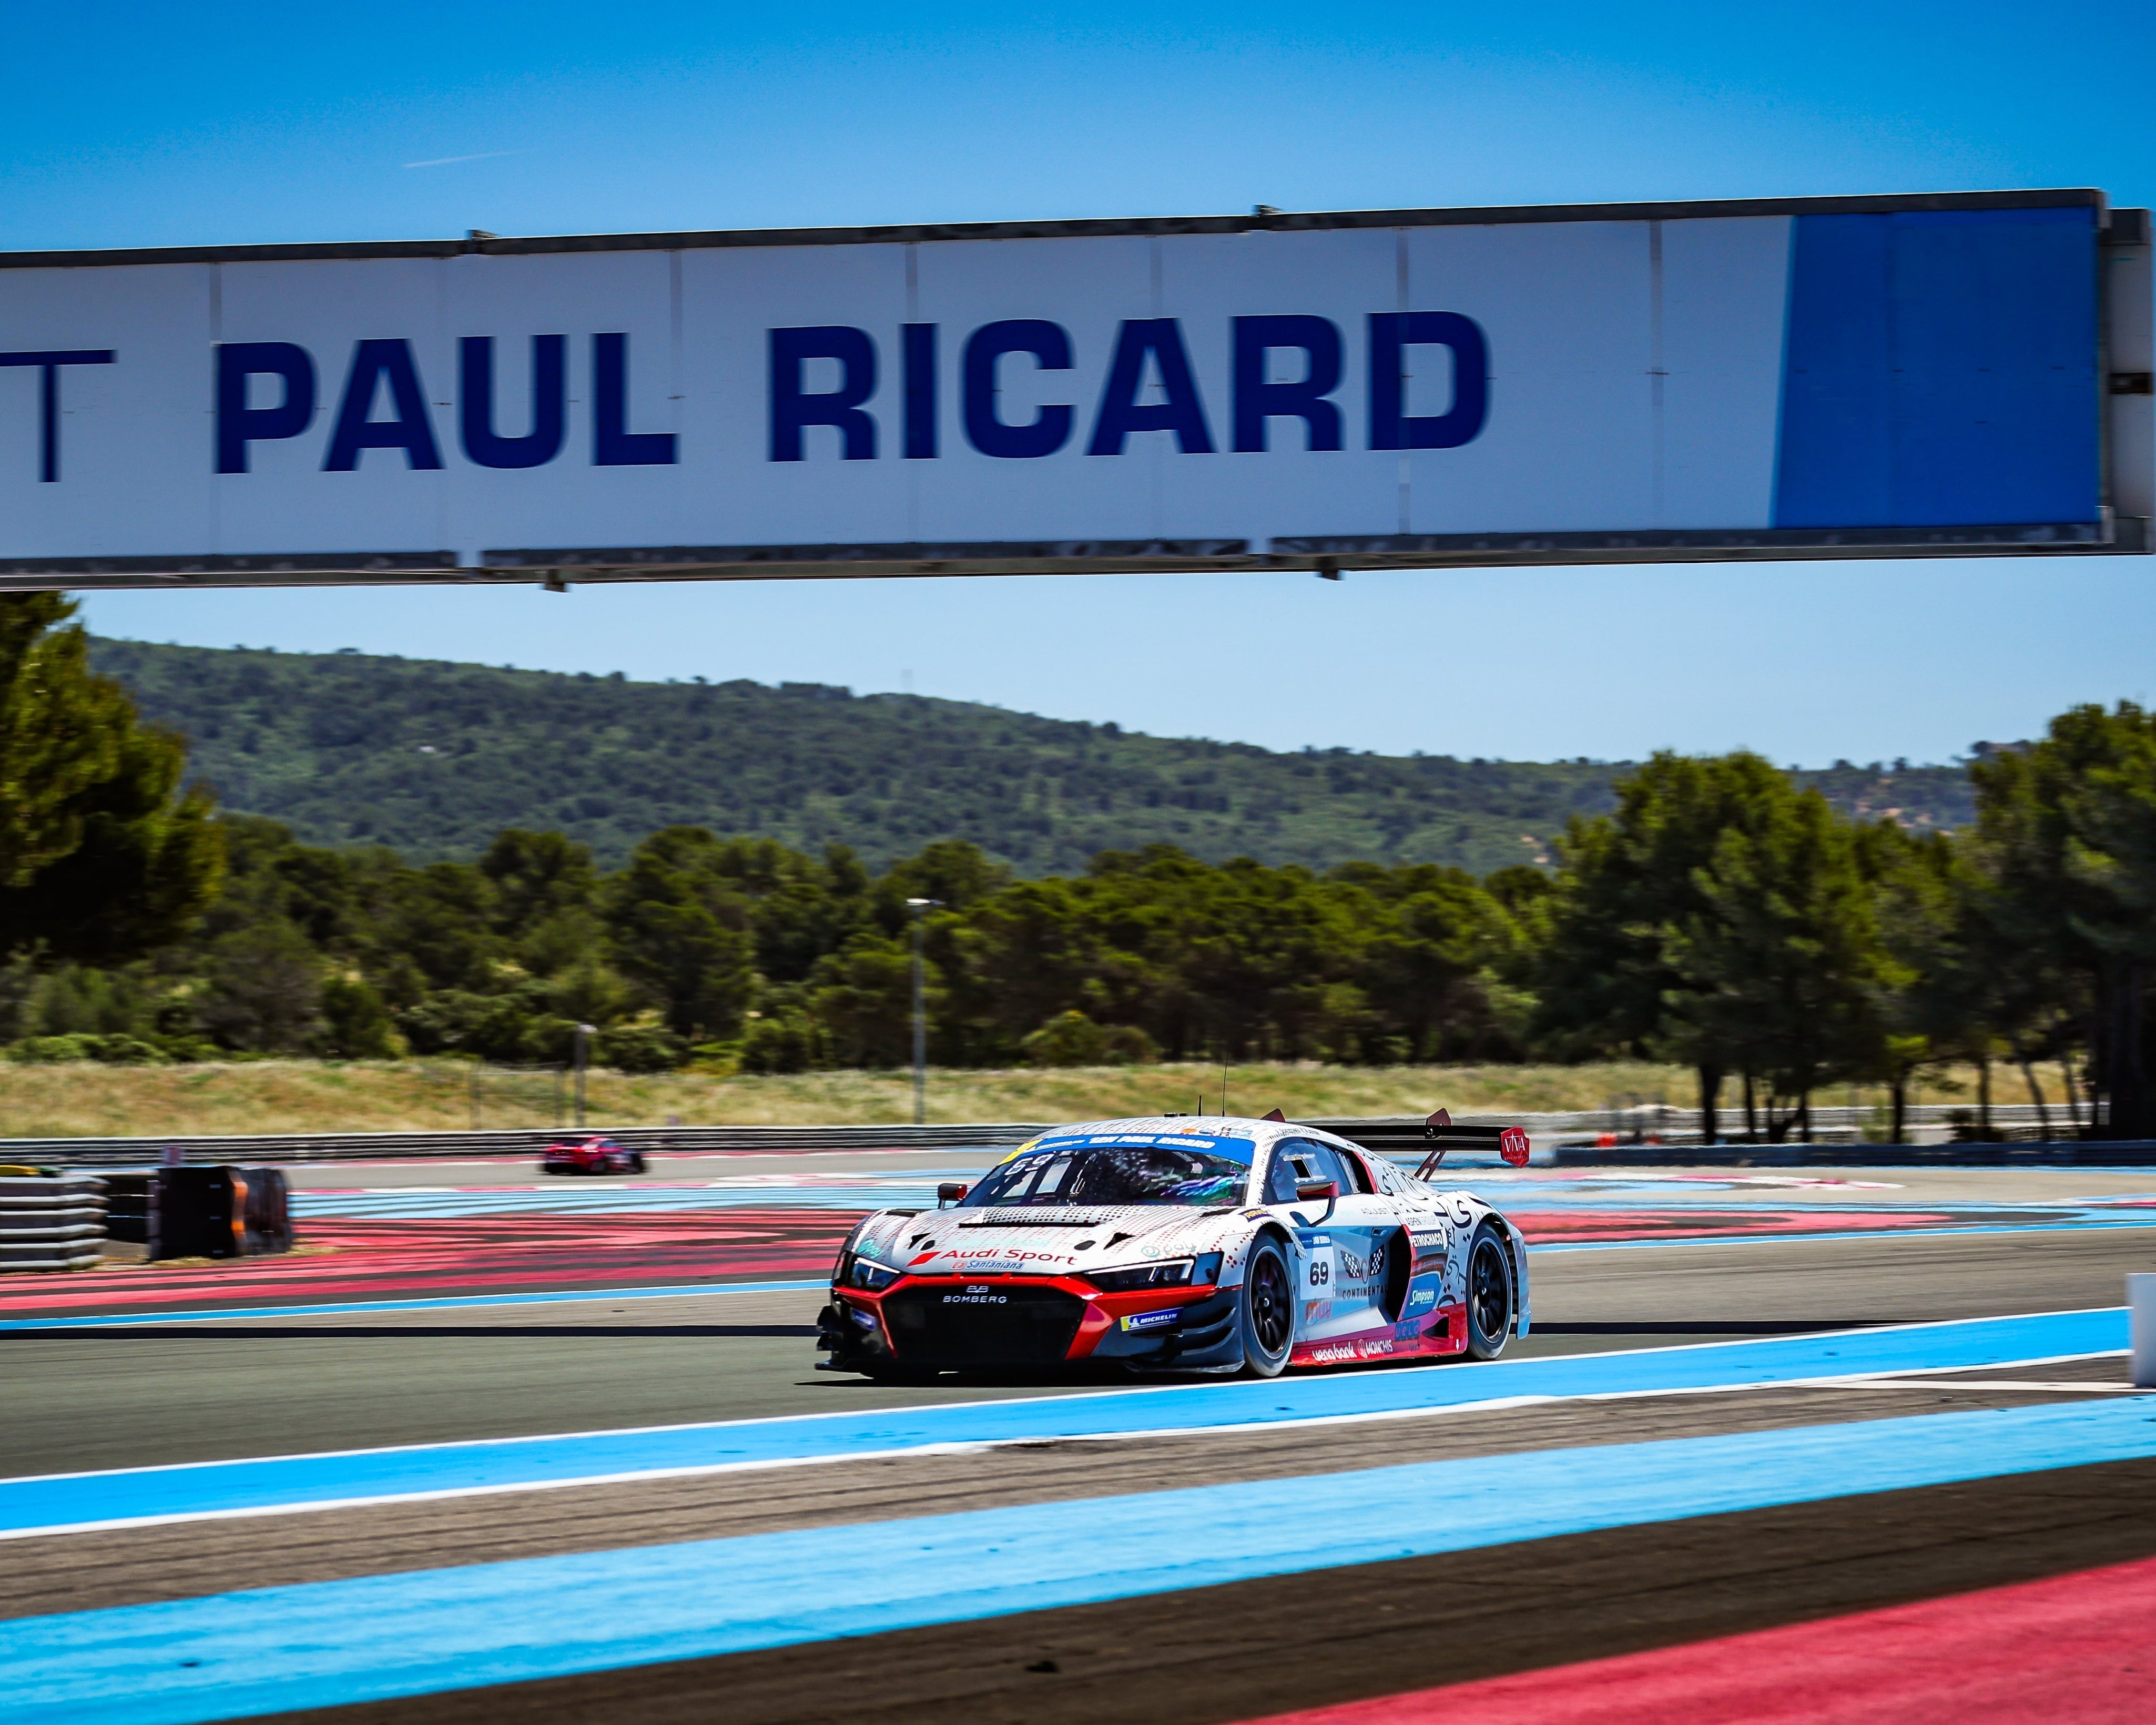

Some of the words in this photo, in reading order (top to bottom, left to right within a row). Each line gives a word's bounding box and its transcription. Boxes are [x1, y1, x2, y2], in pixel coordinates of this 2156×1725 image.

[213, 331, 680, 475] PAUL
[767, 310, 1493, 462] RICARD
[1156, 1137, 1216, 1149] RICARD
[1504, 1129, 1526, 1152] VIVA
[1004, 1153, 1054, 1175] 69
[1408, 1232, 1443, 1247] PETROCHACO
[940, 1249, 1000, 1260] Audi
[1004, 1250, 1078, 1265] Sport
[1309, 1262, 1329, 1286] 69
[943, 1295, 1008, 1304] BOMBERG
[1342, 1284, 1388, 1300] CONTINENTAL
[1410, 1290, 1434, 1306] Simpson
[1140, 1313, 1177, 1324] MICHELIN
[1366, 1339, 1393, 1355] MONCHIS
